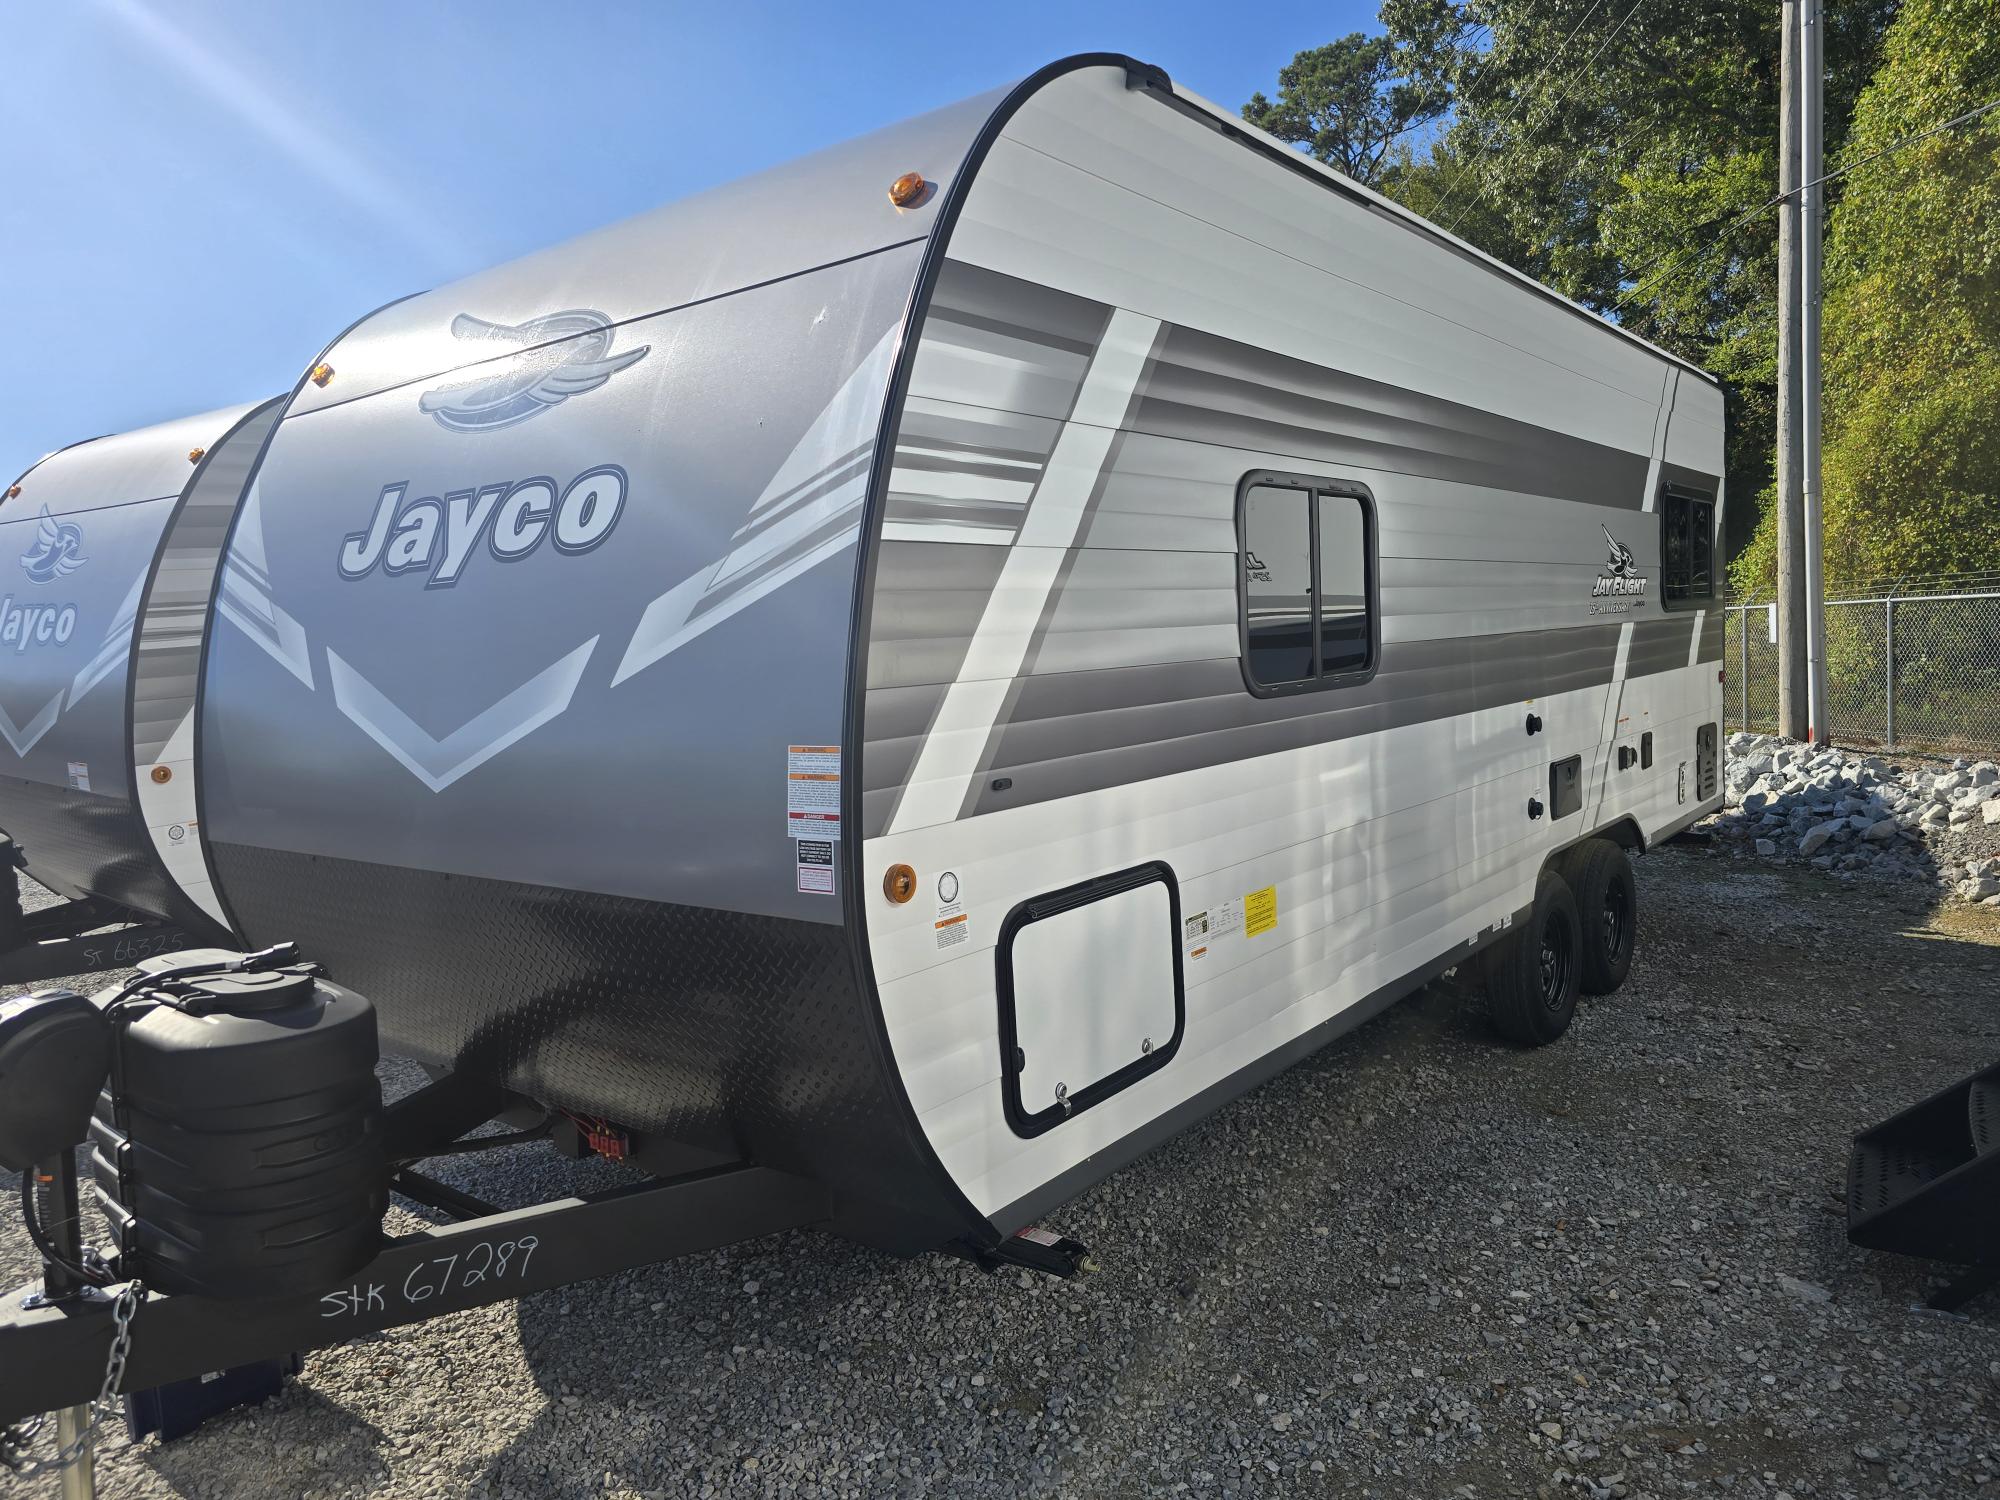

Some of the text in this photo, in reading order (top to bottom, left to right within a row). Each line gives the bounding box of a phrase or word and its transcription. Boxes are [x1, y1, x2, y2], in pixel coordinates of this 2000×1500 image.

[338, 464, 629, 591] Jayco
[1592, 575, 1648, 597] JAY FLIGHT
[113, 932, 185, 961] 66325
[403, 1235, 539, 1304] 67289
